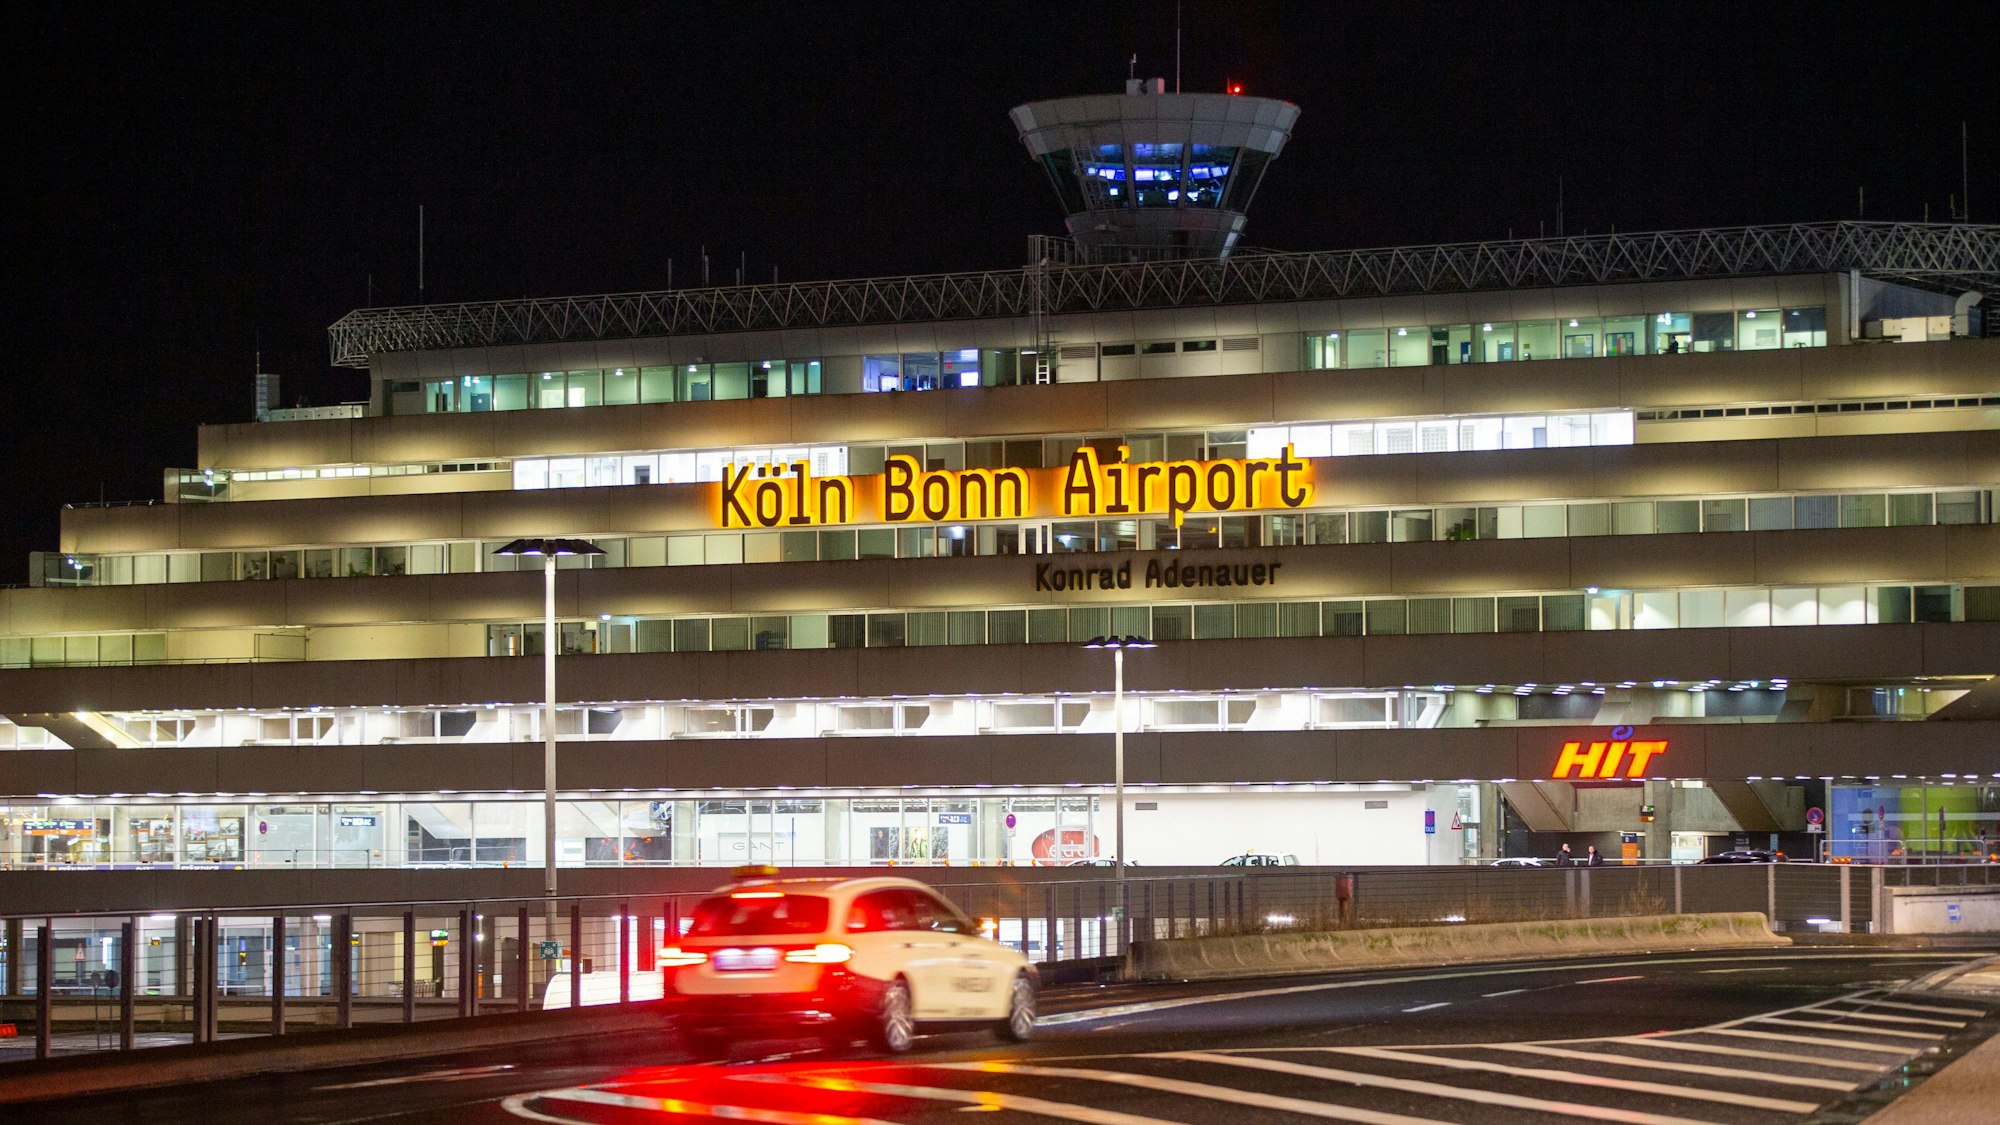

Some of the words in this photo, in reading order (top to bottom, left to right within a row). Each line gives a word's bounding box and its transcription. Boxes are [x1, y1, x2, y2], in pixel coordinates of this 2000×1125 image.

[721, 460, 852, 527] Köln
[884, 455, 1029, 522] Bonn
[1064, 443, 1311, 529] Airport
[1035, 560, 1132, 591] Konrad
[1144, 558, 1282, 589] Adenauer
[1552, 728, 1669, 779] HIT
[732, 840, 785, 851] GANT
